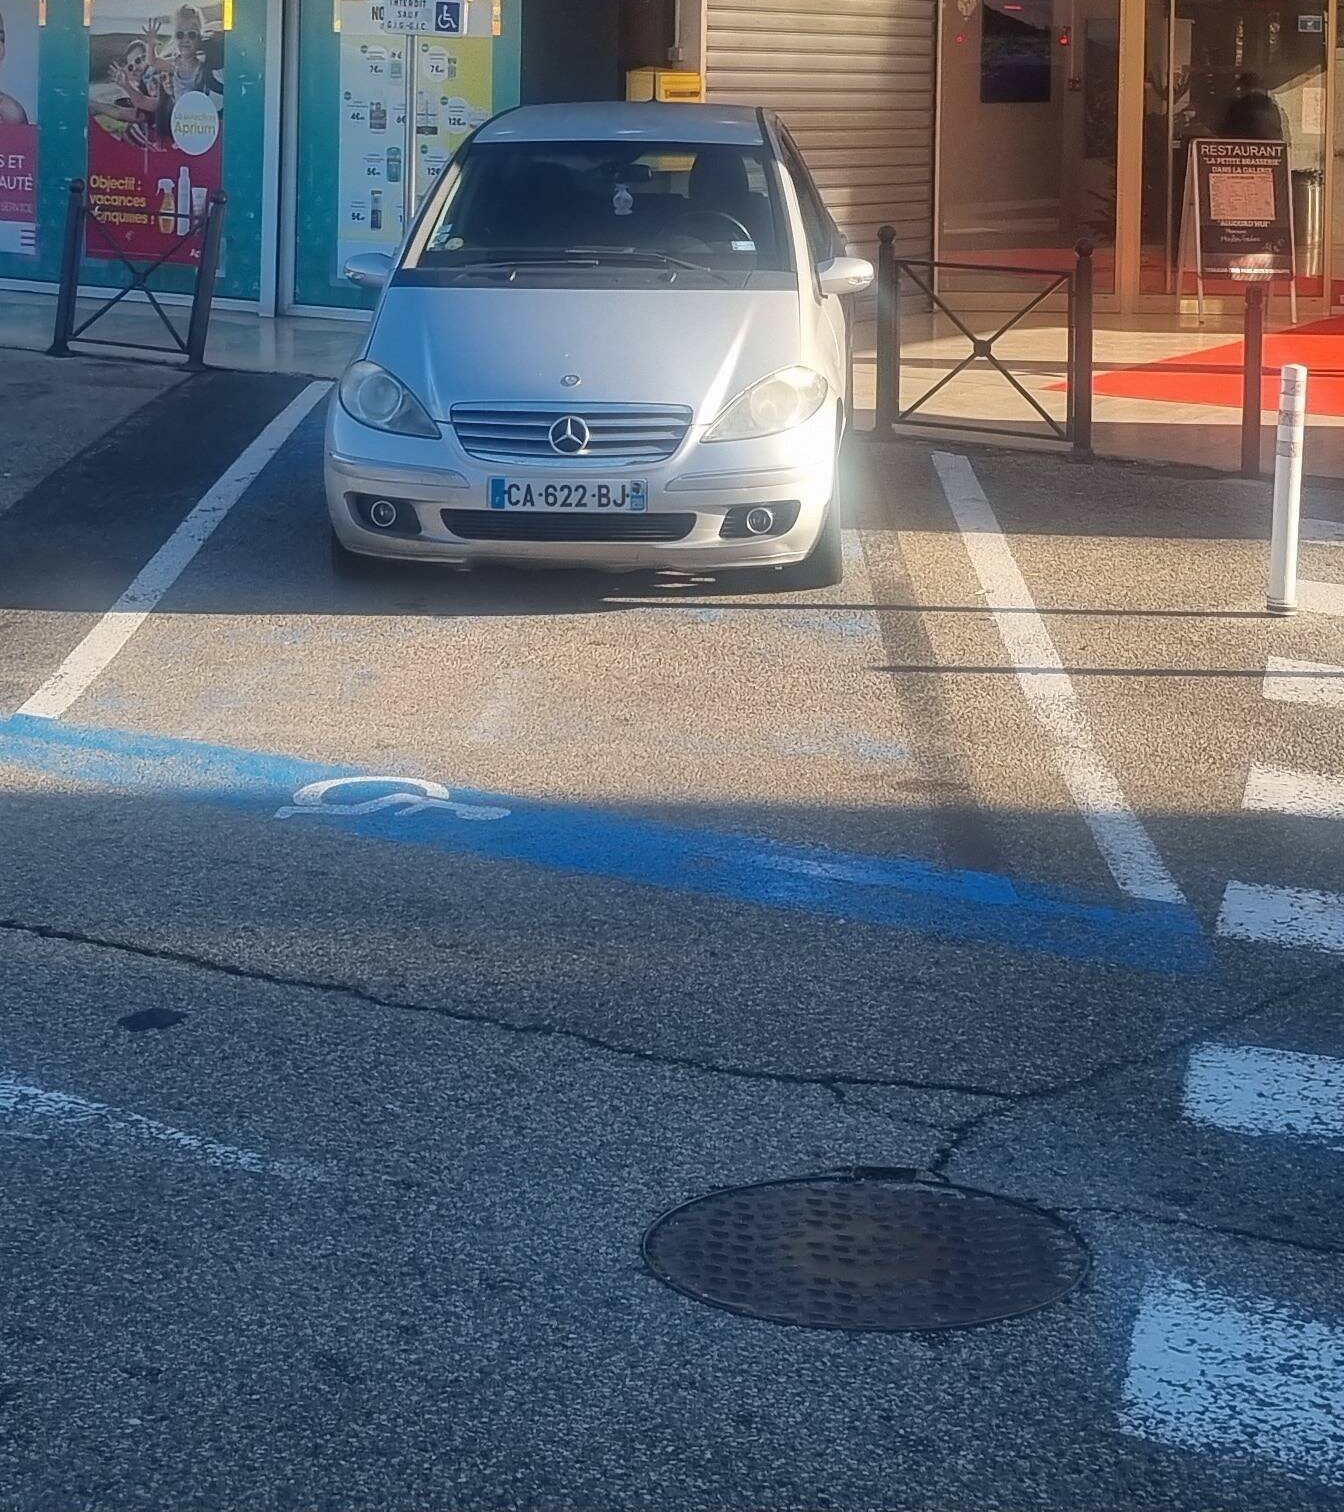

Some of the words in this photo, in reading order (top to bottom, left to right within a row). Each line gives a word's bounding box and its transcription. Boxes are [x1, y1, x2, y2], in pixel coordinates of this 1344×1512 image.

[397, 10, 419, 18] SAUF
[174, 122, 216, 136] Aprium
[1200, 145, 1284, 157] RESTAURANT
[8, 155, 25, 169] ET
[89, 194, 147, 207] vacances
[507, 483, 626, 507] CA-622-BJ
